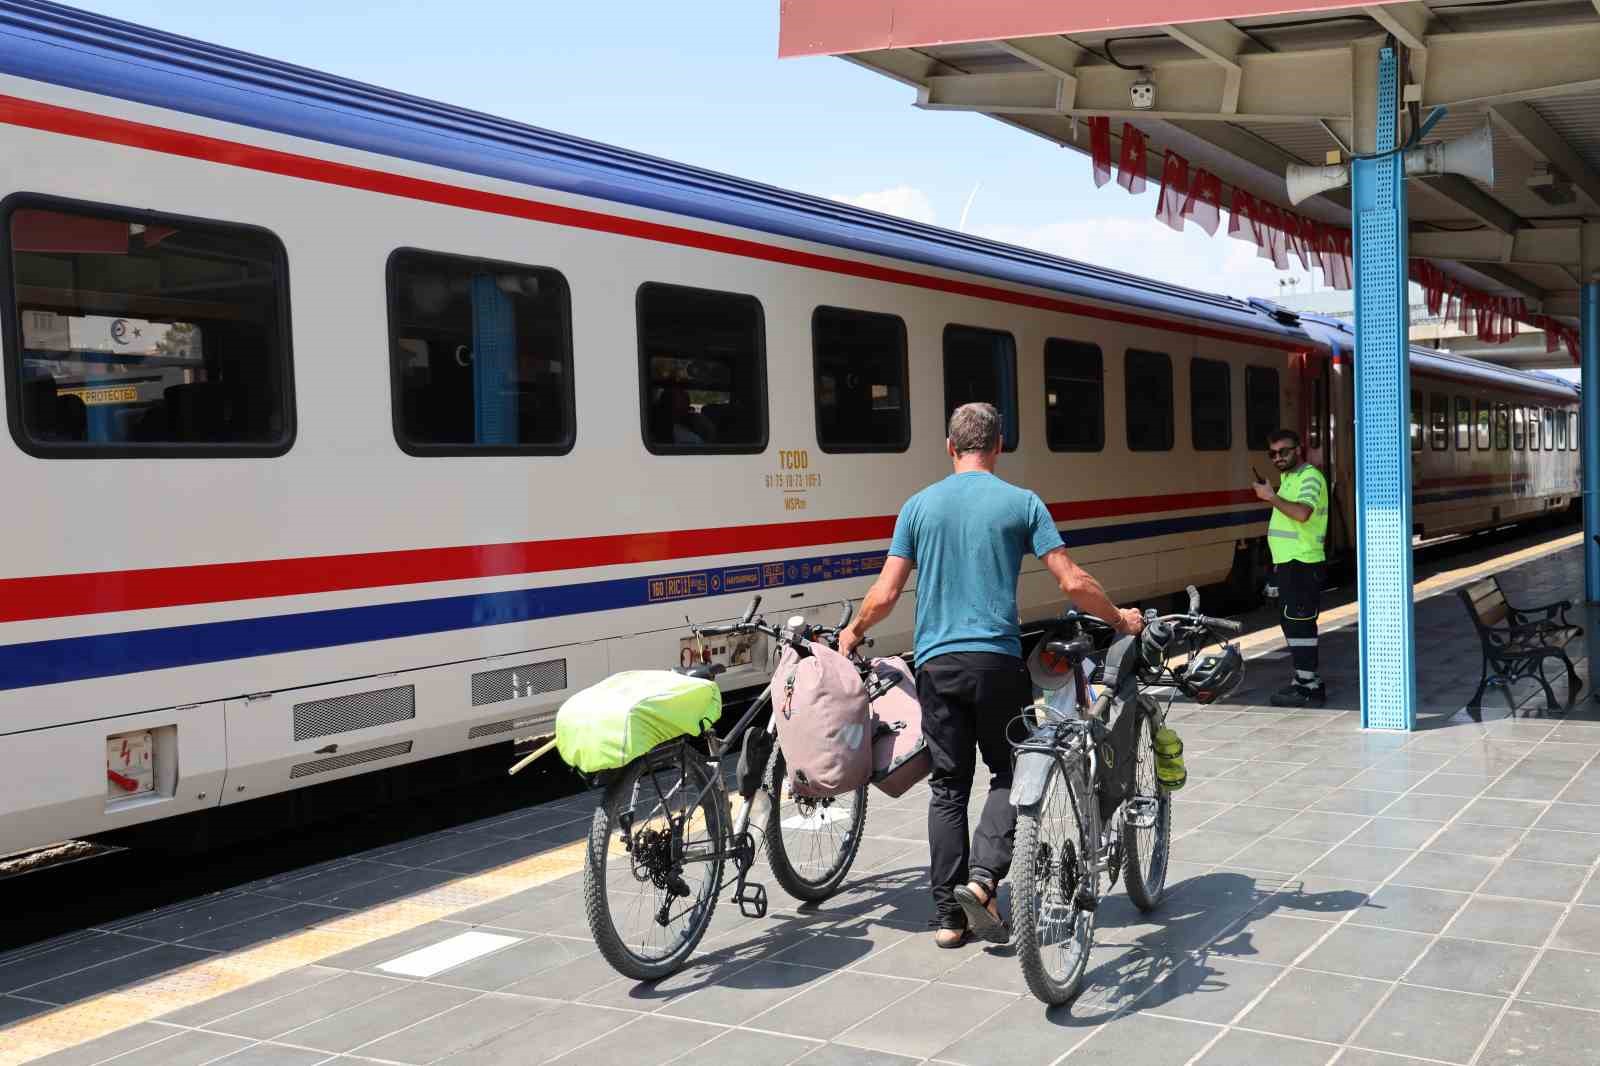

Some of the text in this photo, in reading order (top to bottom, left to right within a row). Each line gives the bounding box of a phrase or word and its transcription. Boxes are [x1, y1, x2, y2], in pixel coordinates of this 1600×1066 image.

[85, 390, 136, 401] PROTECTED
[779, 450, 808, 469] TCDD
[651, 581, 664, 598] 160
[668, 578, 681, 595] RIC
